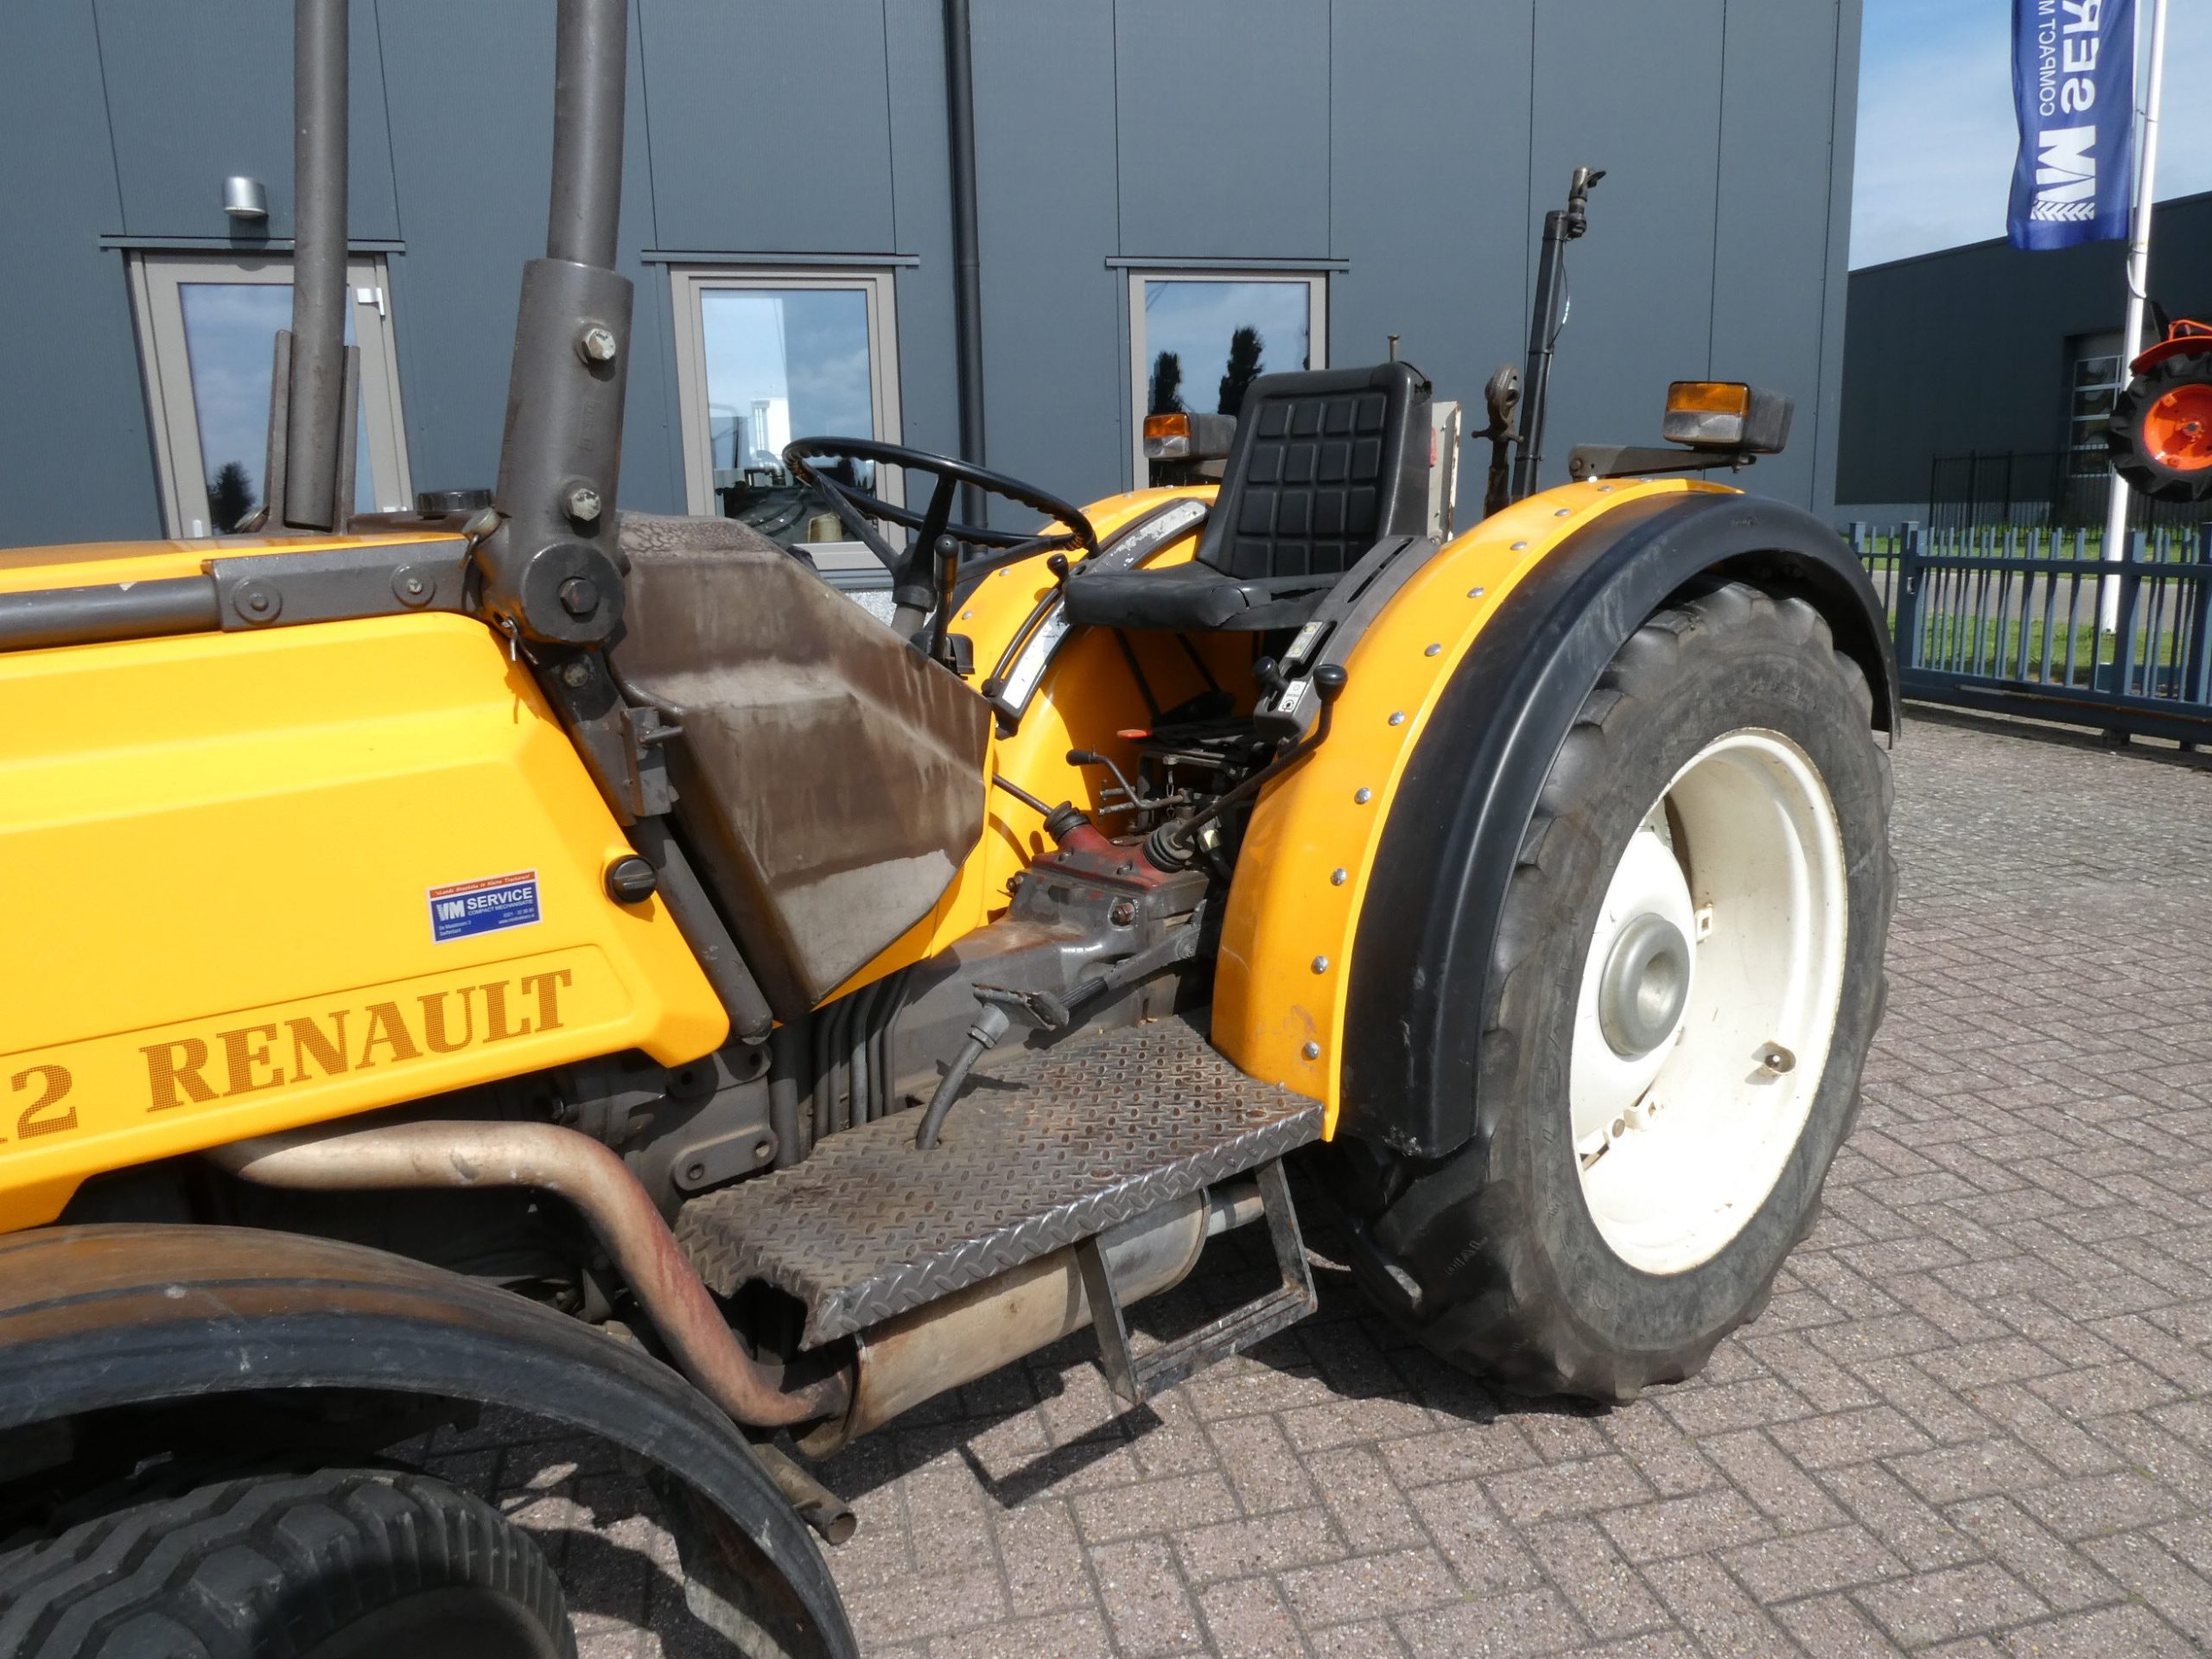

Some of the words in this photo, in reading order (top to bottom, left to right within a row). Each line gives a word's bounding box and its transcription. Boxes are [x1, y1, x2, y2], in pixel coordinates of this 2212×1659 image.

[467, 887, 533, 911] SERVICE
[467, 906, 495, 916] COMPACT
[0, 1064, 79, 1145] 2
[138, 968, 573, 1114] RENAULT
